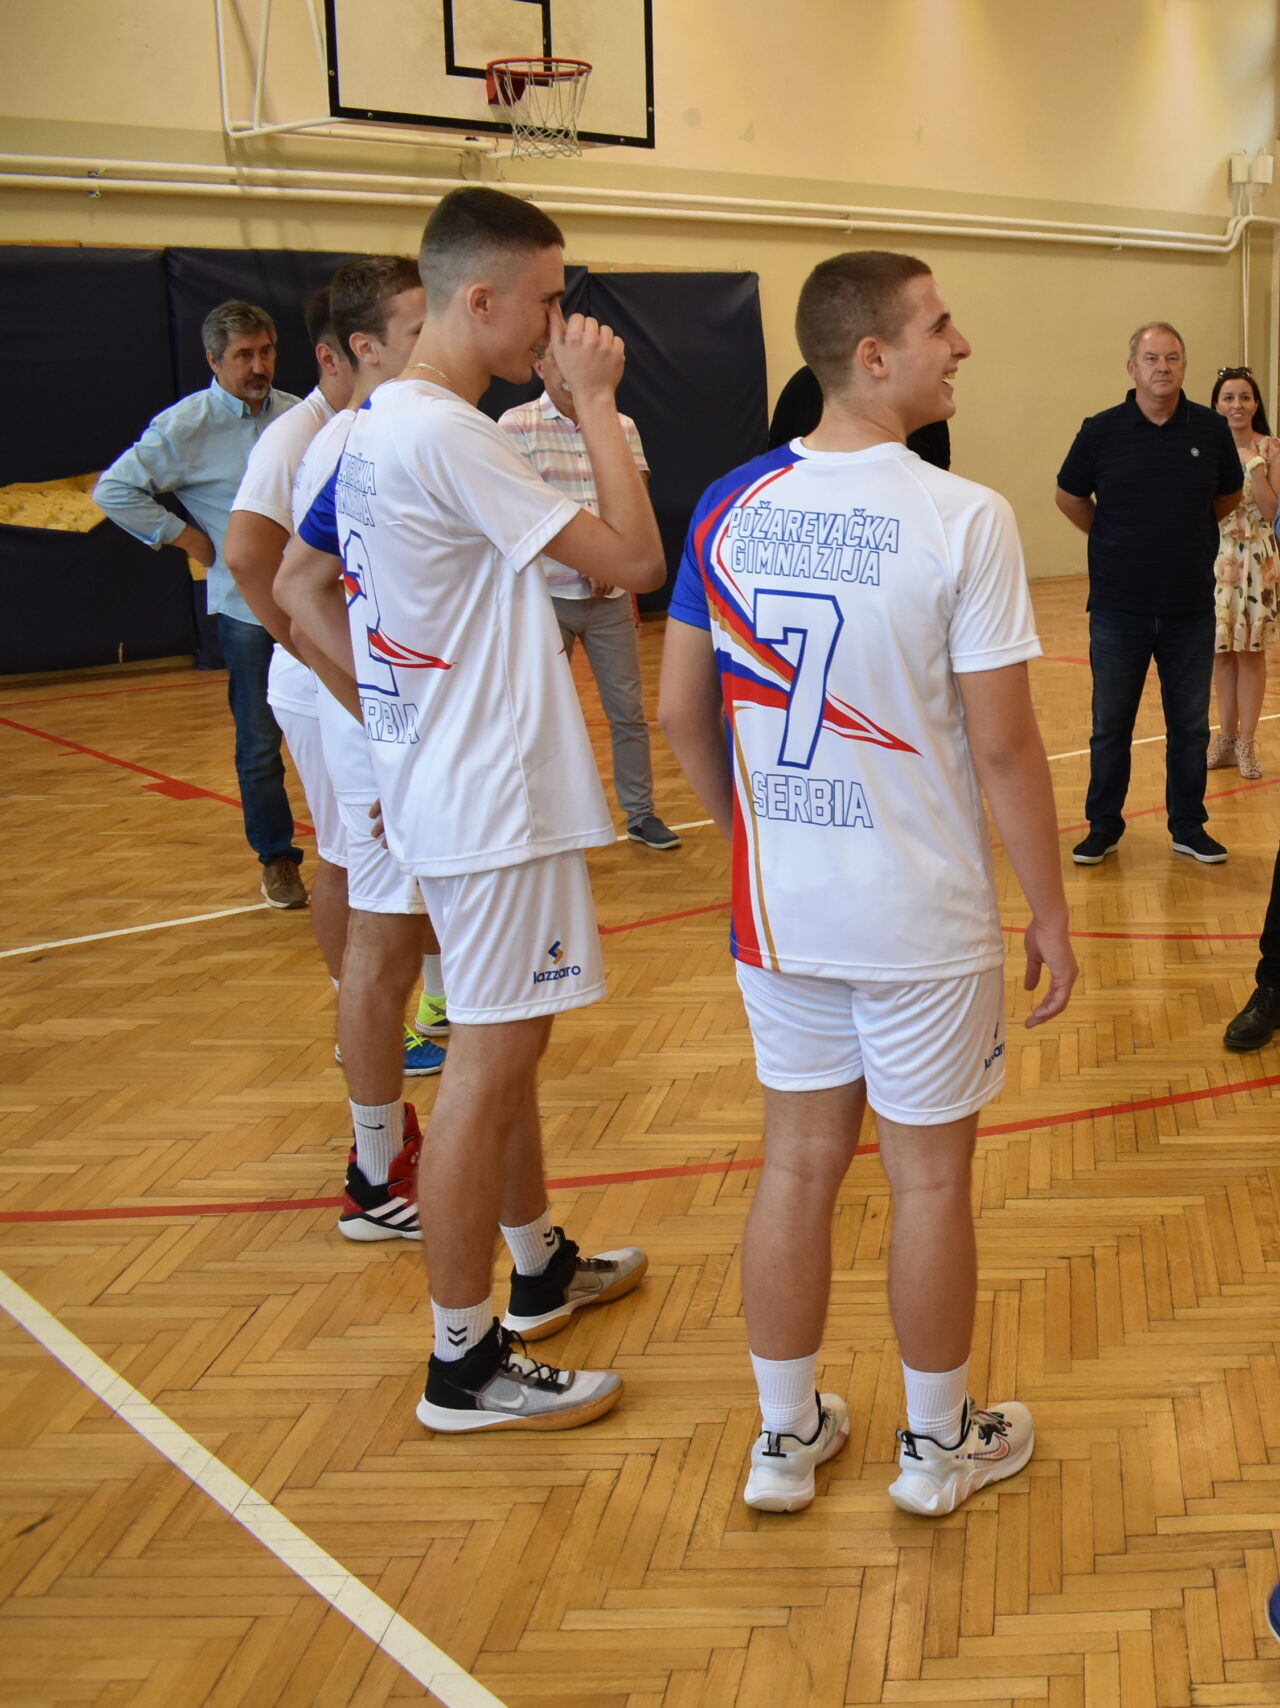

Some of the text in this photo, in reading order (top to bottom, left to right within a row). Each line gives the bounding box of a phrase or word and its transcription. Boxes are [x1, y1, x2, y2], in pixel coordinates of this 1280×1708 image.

[727, 500, 900, 553] POŽAREVAČKA
[731, 539, 880, 586] GIMNAZIJA
[753, 588, 844, 770] 7
[360, 696, 421, 744] RBIA
[751, 771, 874, 828] SERBIA
[533, 965, 581, 984] lazzaro
